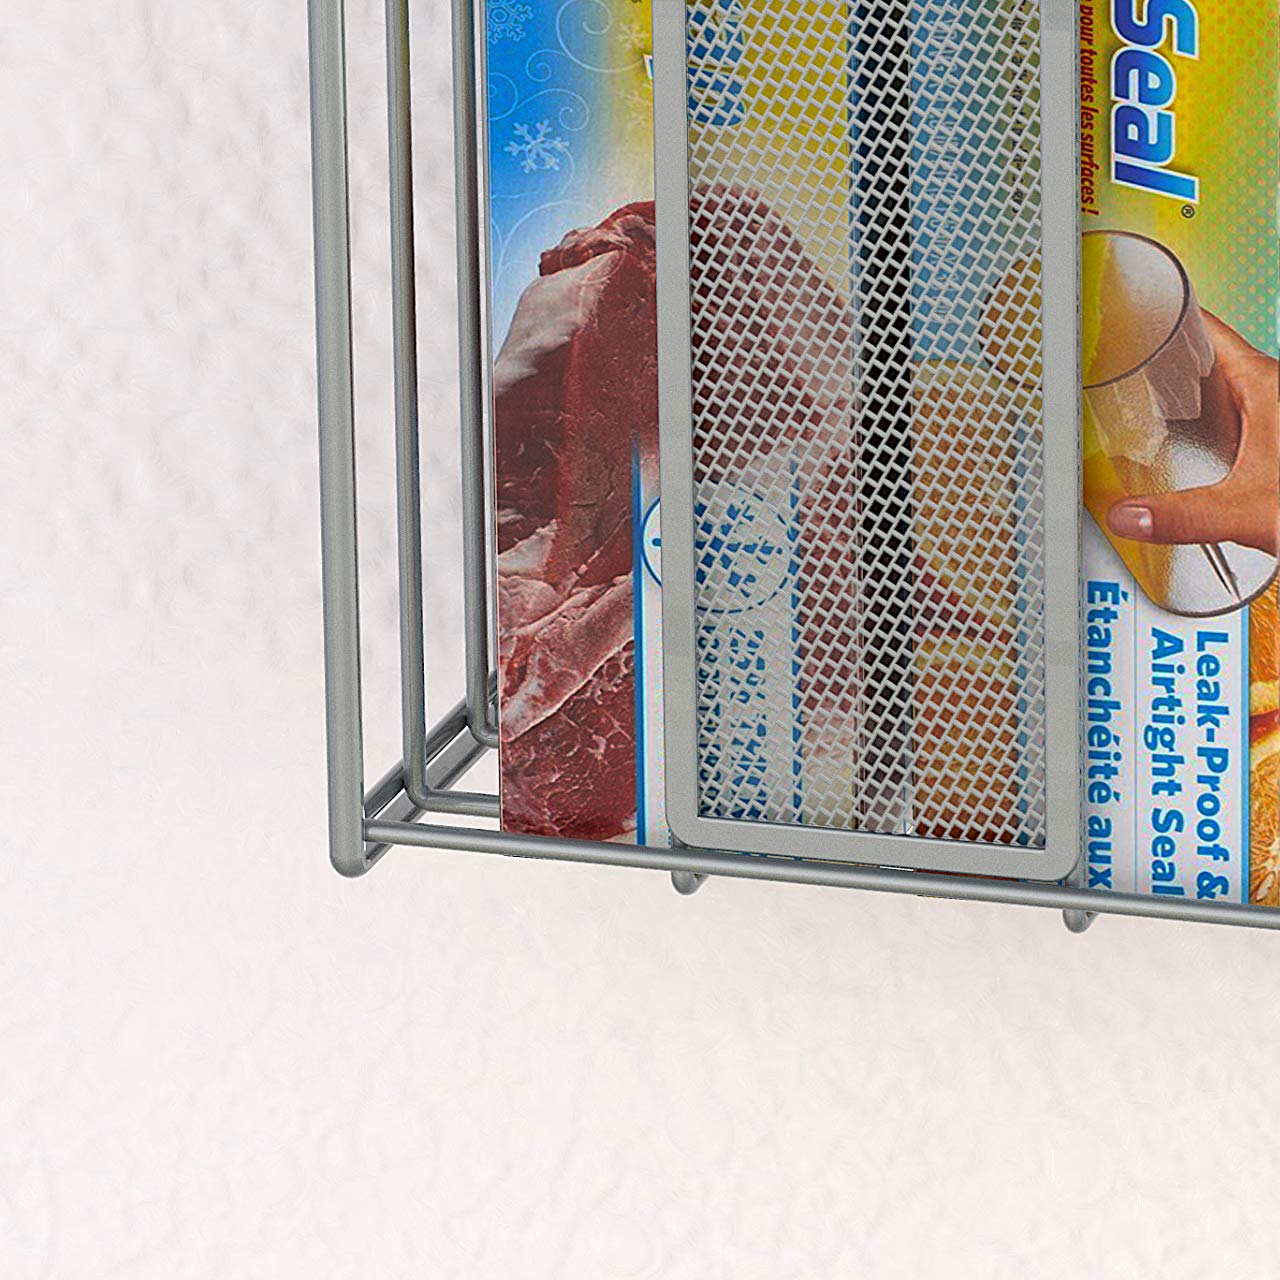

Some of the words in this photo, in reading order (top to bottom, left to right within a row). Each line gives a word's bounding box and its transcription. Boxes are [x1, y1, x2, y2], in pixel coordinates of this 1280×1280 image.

[1079, 6, 1094, 47] pour
[1080, 50, 1098, 104] toutes
[1080, 105, 1099, 130] les
[1080, 132, 1100, 205] surfaces
[1087, 580, 1130, 804] Étanchéité
[1144, 627, 1186, 797] Airtight
[1196, 631, 1230, 862] Leak-Proof
[1088, 817, 1112, 889] aux
[1152, 809, 1186, 896] Seal
[1196, 871, 1230, 900] &
